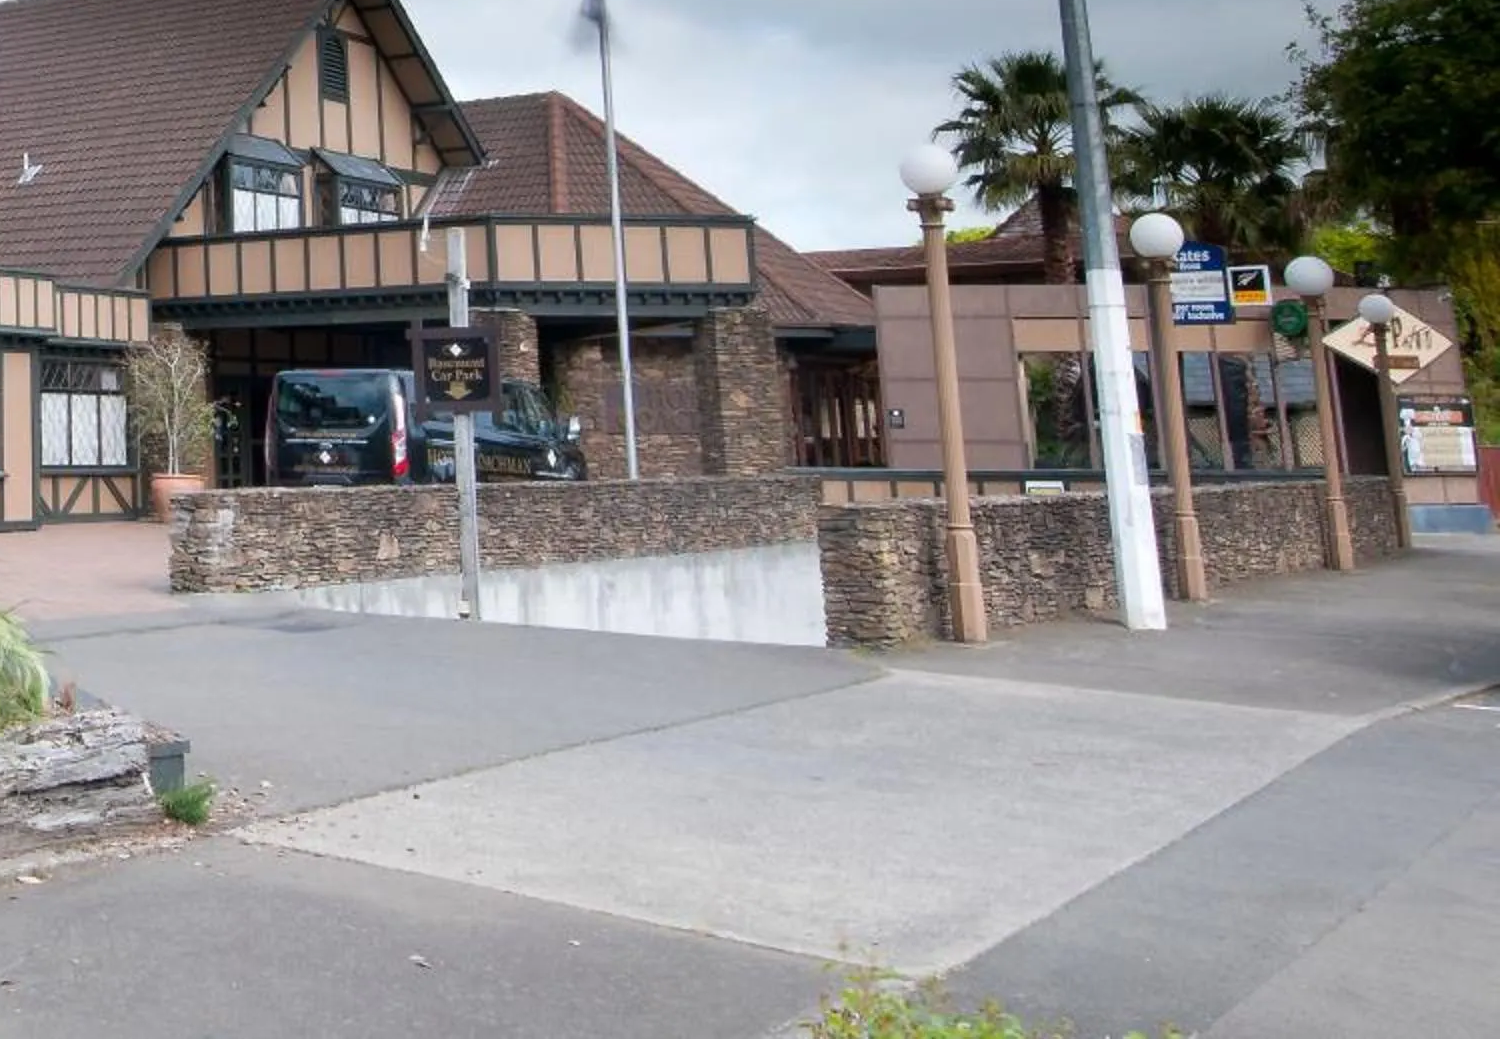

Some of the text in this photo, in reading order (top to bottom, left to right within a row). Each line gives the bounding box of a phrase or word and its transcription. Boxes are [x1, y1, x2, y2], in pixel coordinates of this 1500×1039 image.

[428, 357, 485, 369] Basement
[431, 367, 483, 381] Car Park
